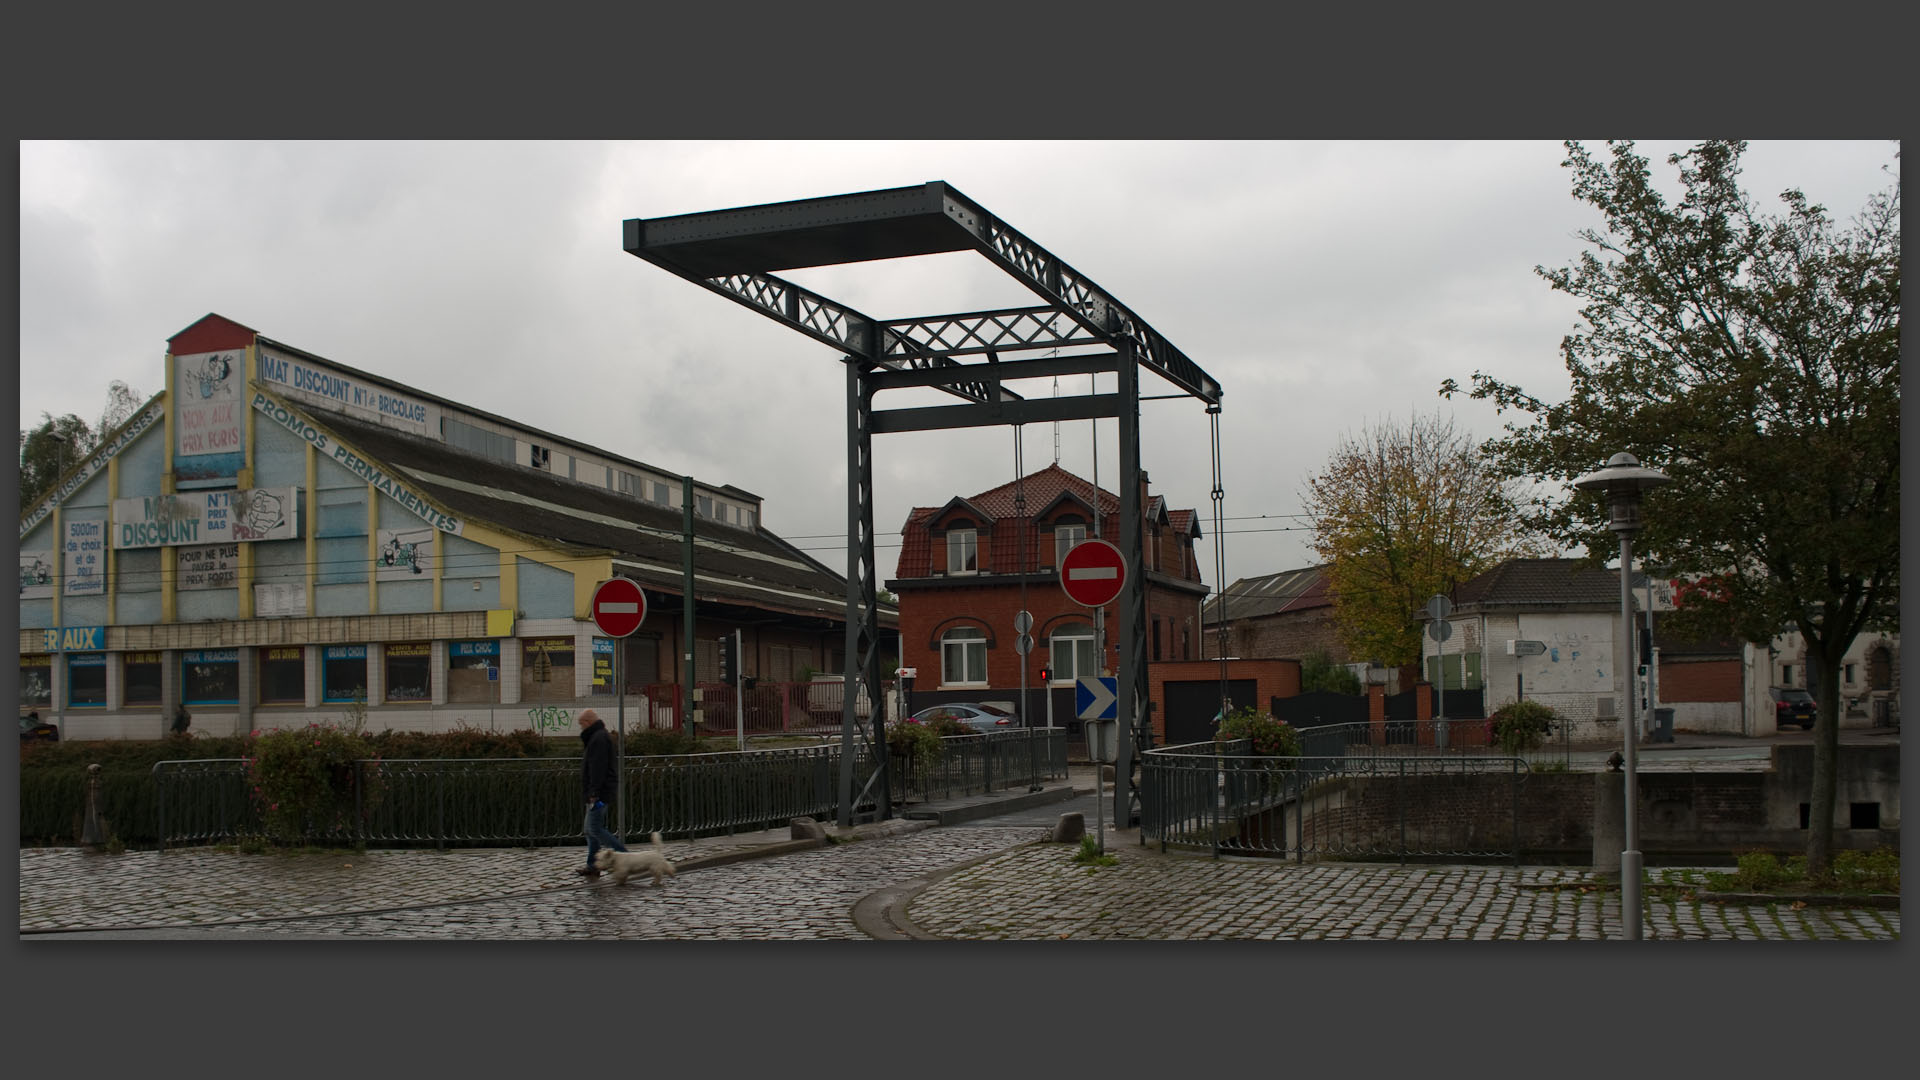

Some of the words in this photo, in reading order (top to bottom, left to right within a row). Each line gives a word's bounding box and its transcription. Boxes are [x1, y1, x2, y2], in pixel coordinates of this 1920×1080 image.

[263, 356, 289, 383] MAT
[294, 367, 350, 402] DISCOUNT
[379, 394, 425, 423] BRICOLAGE
[211, 404, 232, 424] AUX
[91, 410, 153, 471] DECLASSES
[253, 393, 328, 448] PROMOS
[334, 446, 457, 532] PERMANENTES
[208, 510, 227, 519] PRIX
[208, 520, 226, 529] BAS
[122, 519, 200, 546] DISCOUNT
[67, 539, 77, 552] de
[180, 552, 201, 563] POUR
[205, 550, 216, 561] NE
[220, 546, 239, 558] PLUS
[192, 560, 214, 572] PAYER
[219, 560, 227, 570] le
[186, 575, 204, 585] PRIX
[208, 571, 234, 583] FORTS
[475, 642, 492, 654] CHOC
